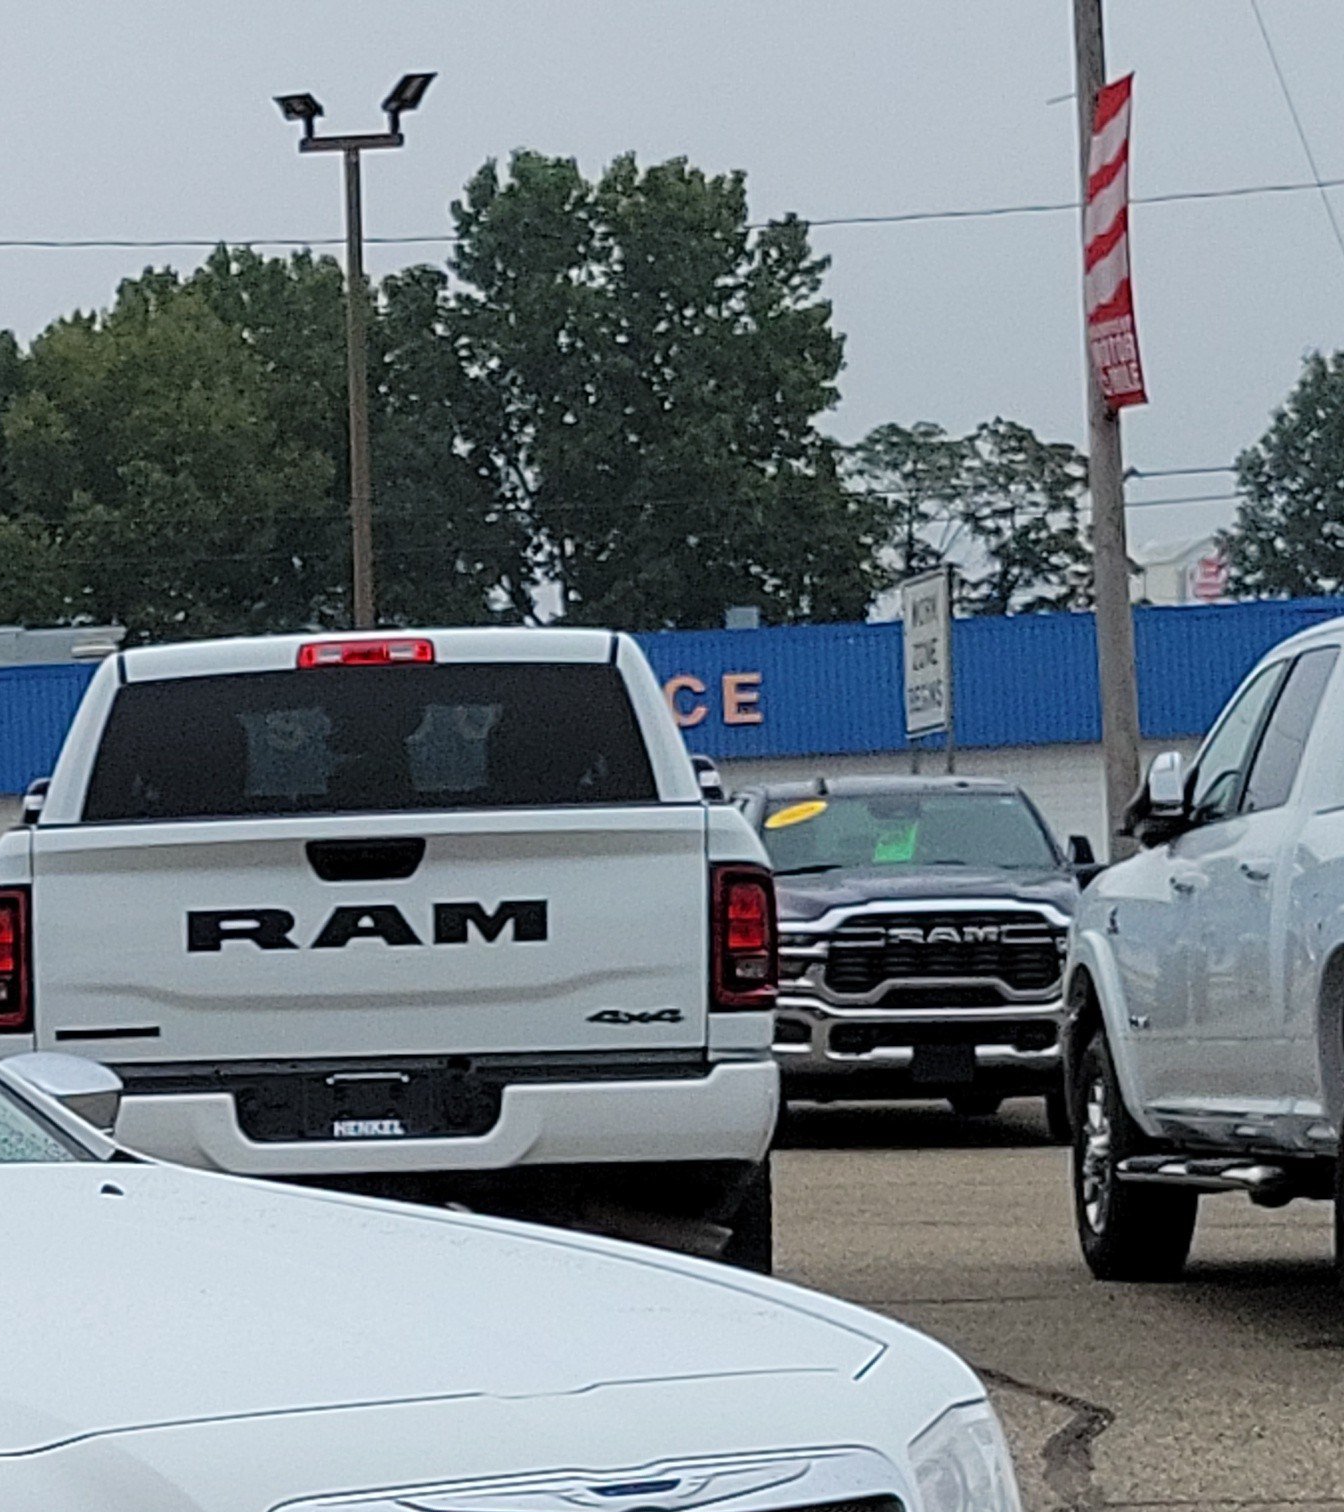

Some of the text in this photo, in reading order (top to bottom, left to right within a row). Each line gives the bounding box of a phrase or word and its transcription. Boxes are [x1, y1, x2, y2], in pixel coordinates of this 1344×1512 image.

[186, 898, 549, 953] RAM
[887, 926, 1000, 944] RAM
[333, 1118, 405, 1137] HENKEL
